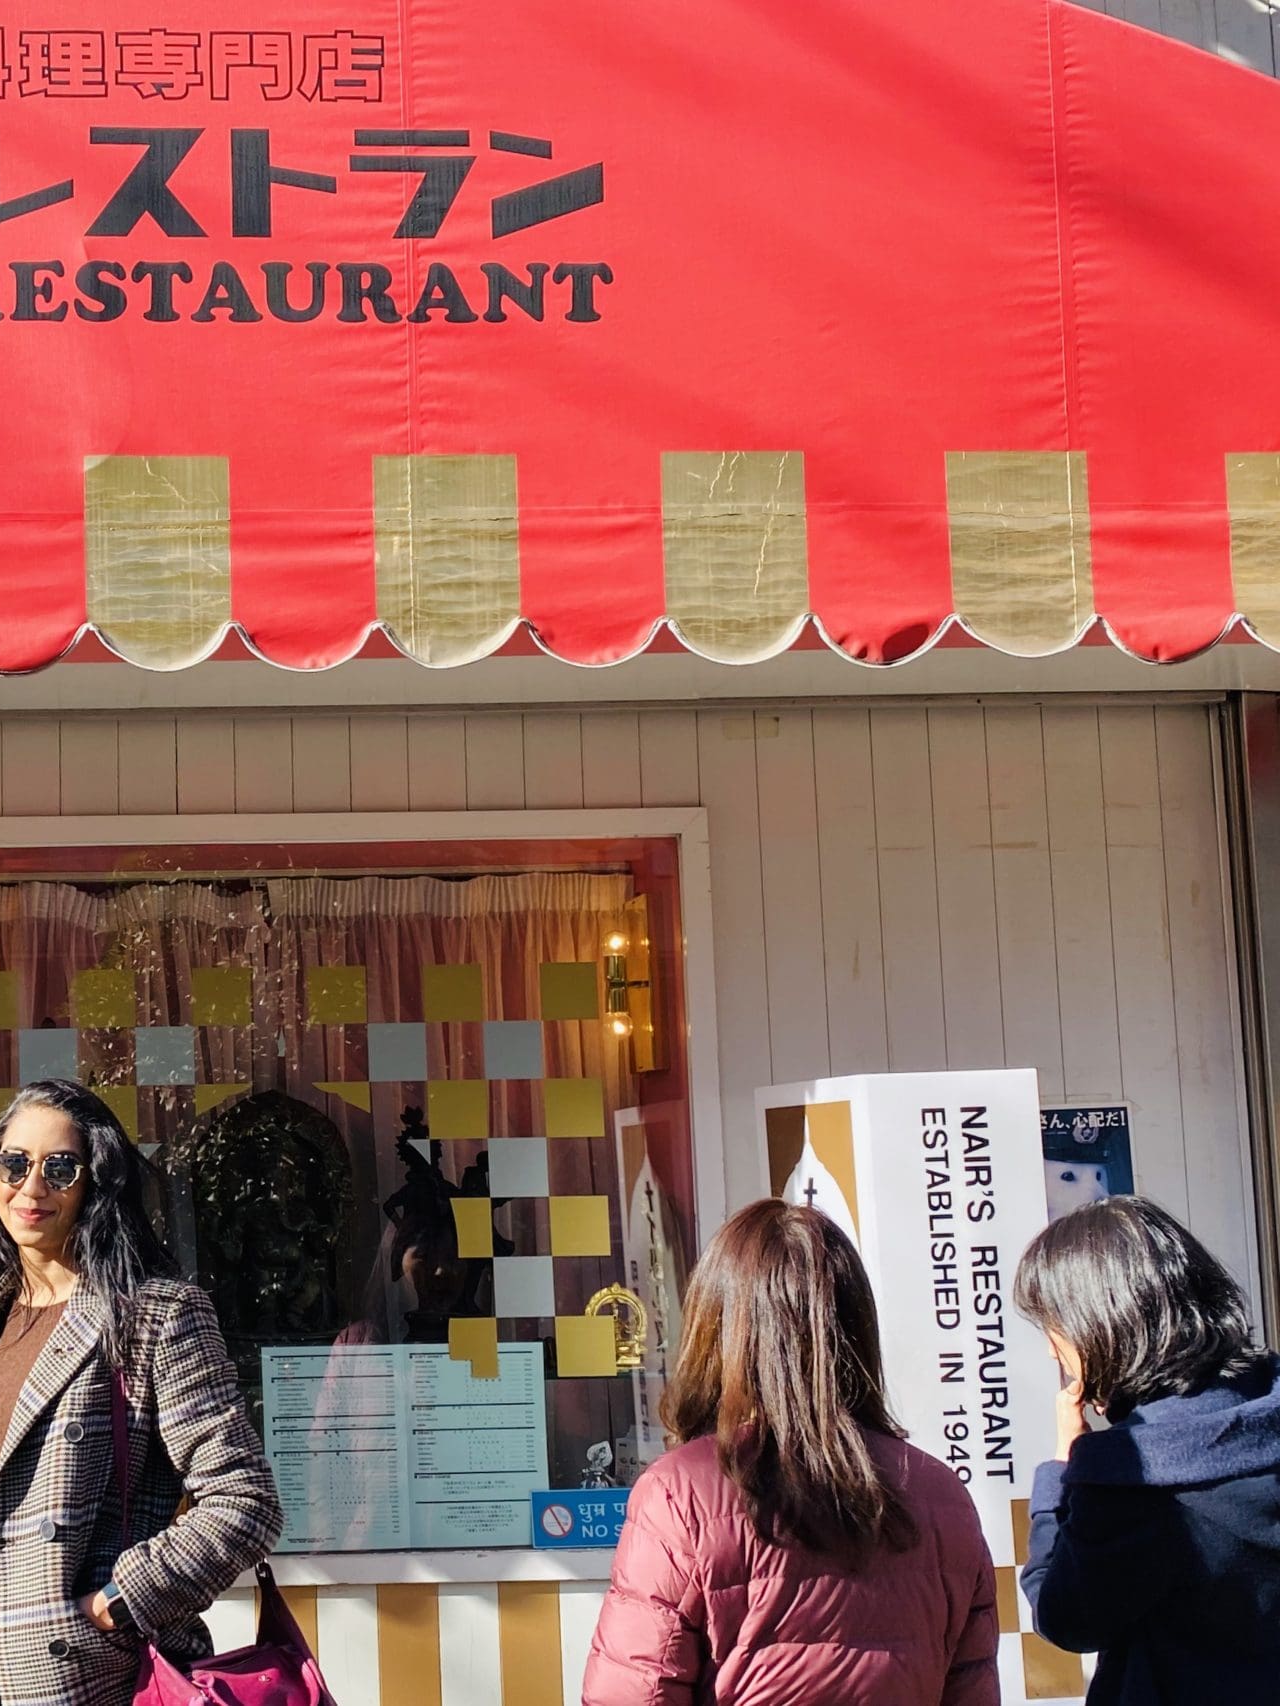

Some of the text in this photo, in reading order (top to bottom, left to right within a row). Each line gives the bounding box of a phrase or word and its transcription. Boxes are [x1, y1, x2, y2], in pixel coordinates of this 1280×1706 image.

[921, 1107, 962, 1330] ESTABLISHED
[960, 1105, 1015, 1484] NAIR'S RESTAURANT
[939, 1352, 965, 1383] IN
[581, 1524, 609, 1538] NO
